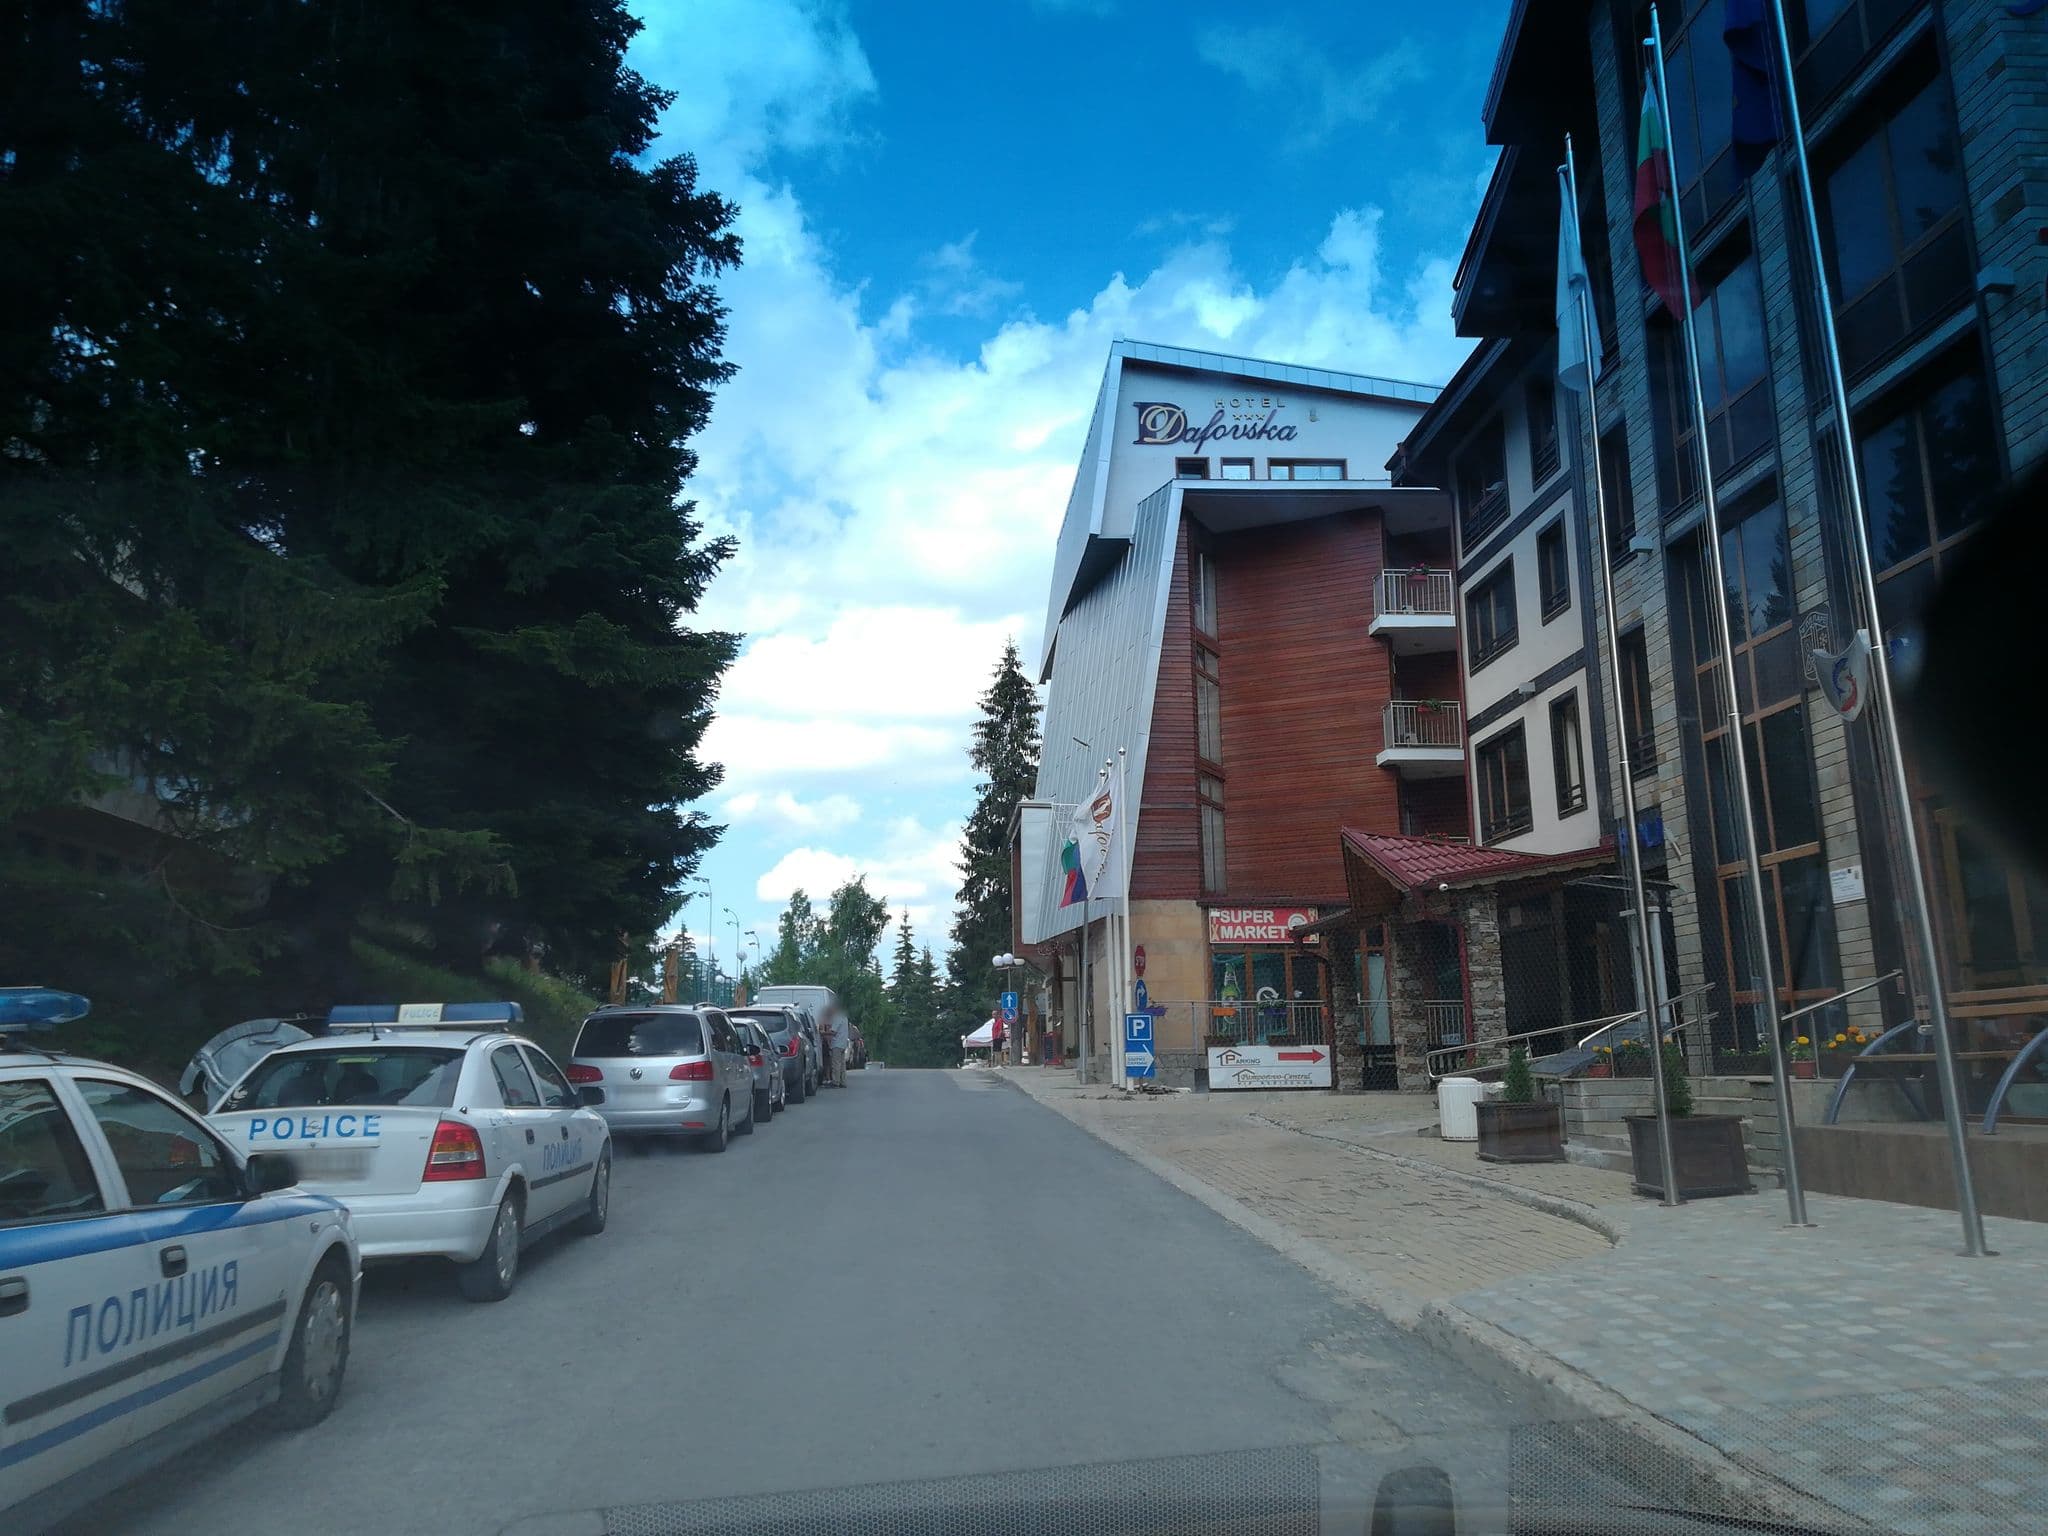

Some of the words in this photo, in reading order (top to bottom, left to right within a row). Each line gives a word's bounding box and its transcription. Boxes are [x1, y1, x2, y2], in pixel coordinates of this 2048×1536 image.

[1215, 398, 1286, 408] HOTEL
[1133, 401, 1298, 454] Dafovska
[1220, 909, 1274, 923] SUPER
[1221, 925, 1288, 939] MARKET
[1132, 1018, 1146, 1037] P
[1225, 1054, 1261, 1065] PARKING
[248, 1115, 382, 1141] POLICE
[64, 1260, 238, 1369] ПОЛИЦИЯ
